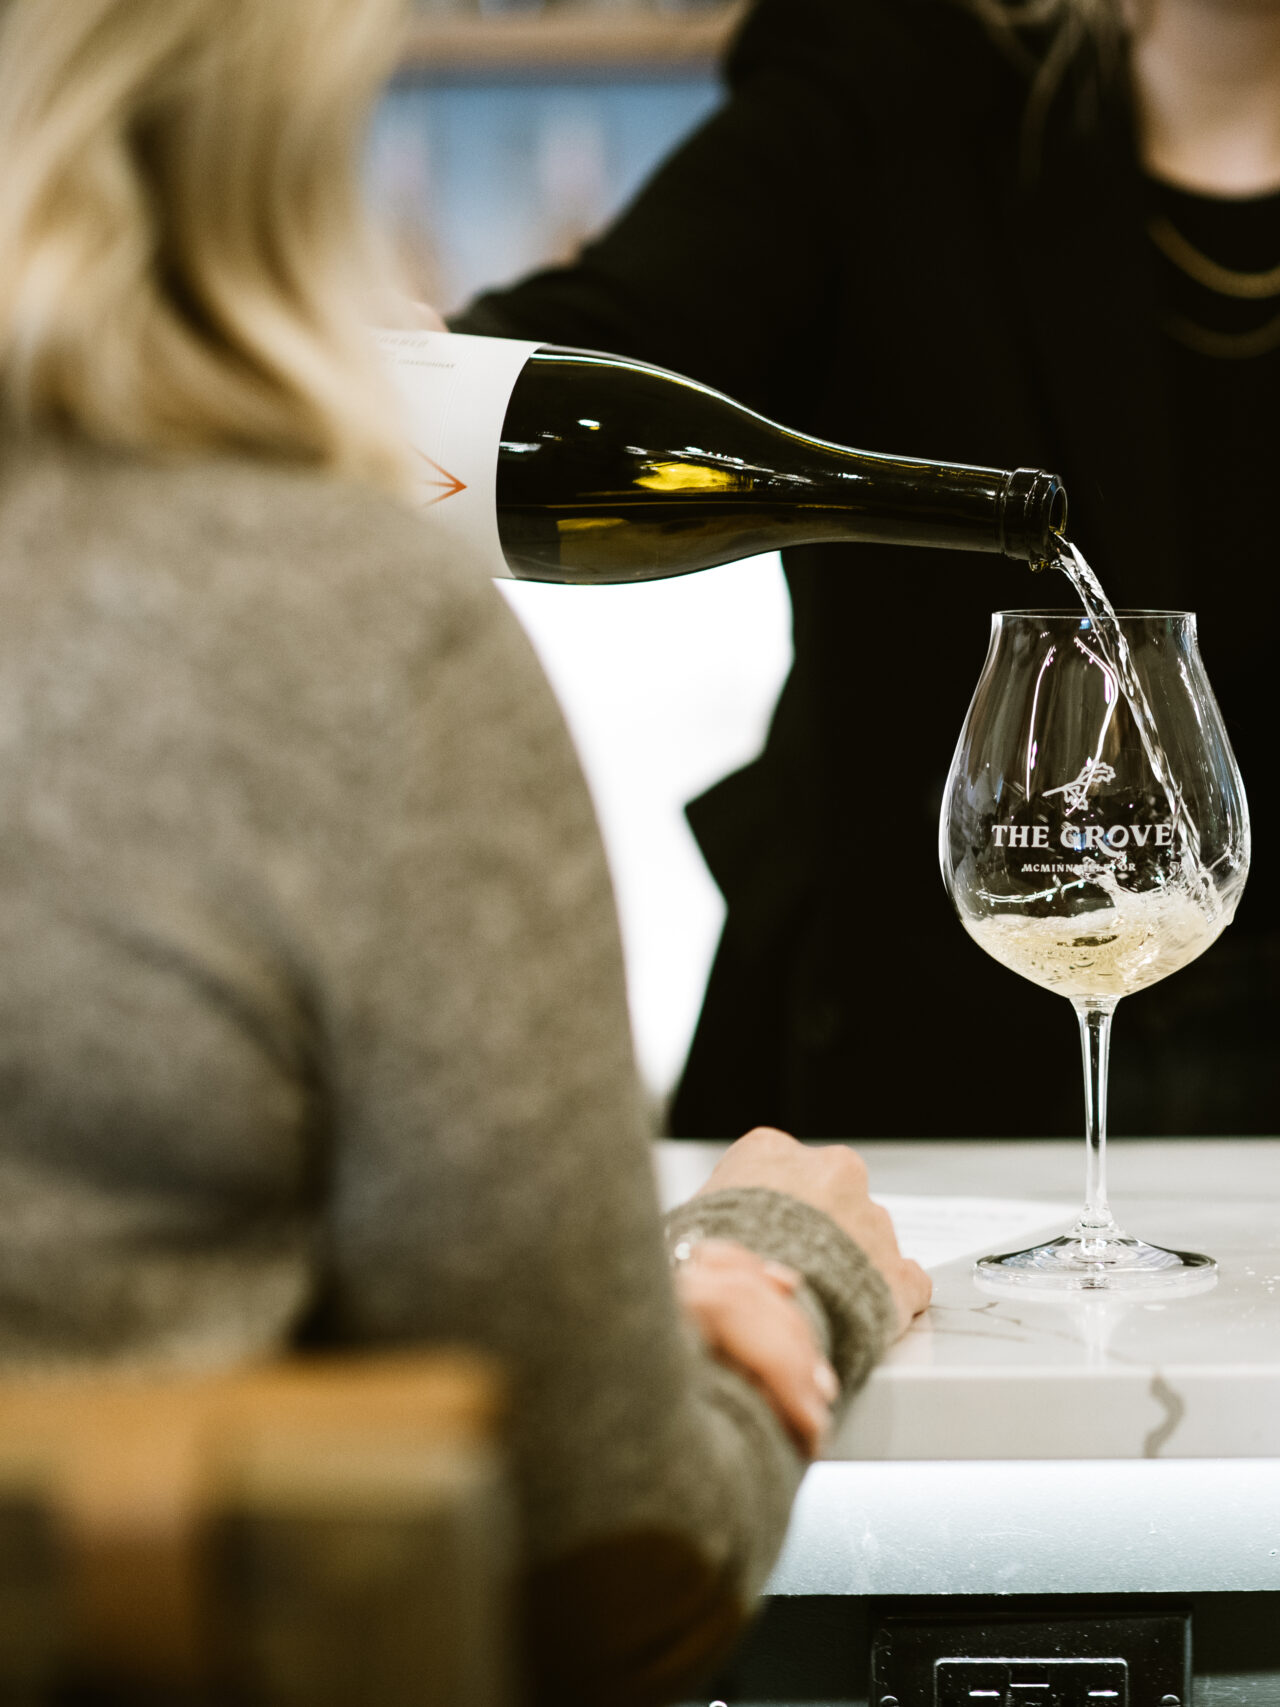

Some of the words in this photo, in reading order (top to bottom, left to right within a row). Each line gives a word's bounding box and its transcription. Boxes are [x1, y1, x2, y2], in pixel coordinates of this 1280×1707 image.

[991, 824, 1049, 849] THE
[1060, 824, 1173, 858] GROVE
[1022, 863, 1111, 873] MCMINN
[1120, 863, 1137, 872] OR
